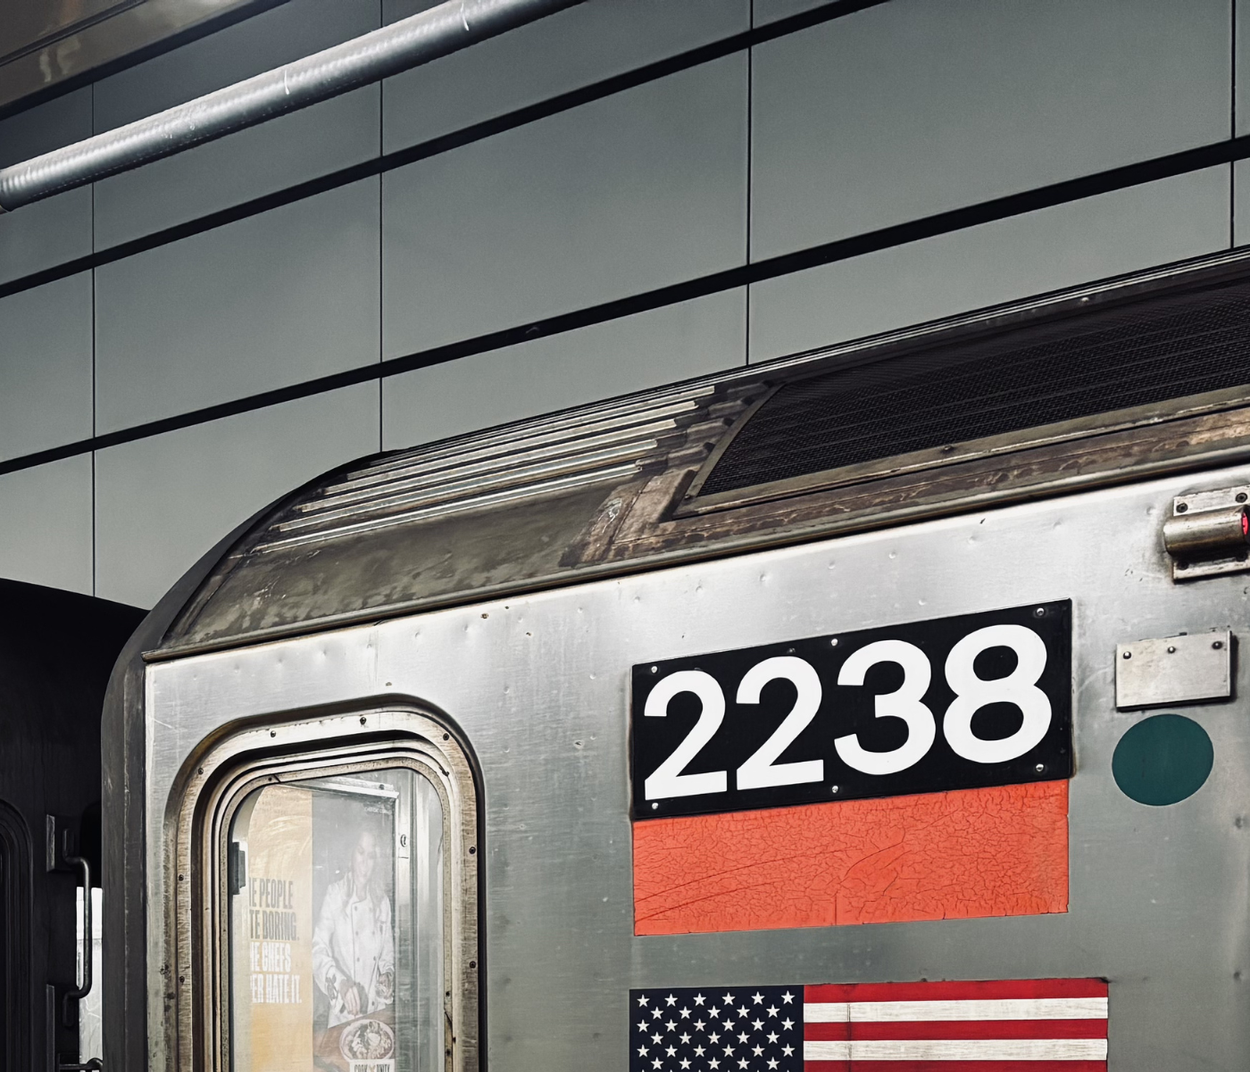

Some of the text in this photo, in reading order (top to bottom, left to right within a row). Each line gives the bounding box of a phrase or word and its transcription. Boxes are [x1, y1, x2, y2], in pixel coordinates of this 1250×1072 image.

[644, 624, 1053, 801] 2238
[249, 876, 294, 909] E PEOPLE
[262, 911, 300, 941] BORING.
[261, 941, 292, 973] CHEFS
[249, 973, 264, 1004] ER
[266, 974, 289, 1004] HATE
